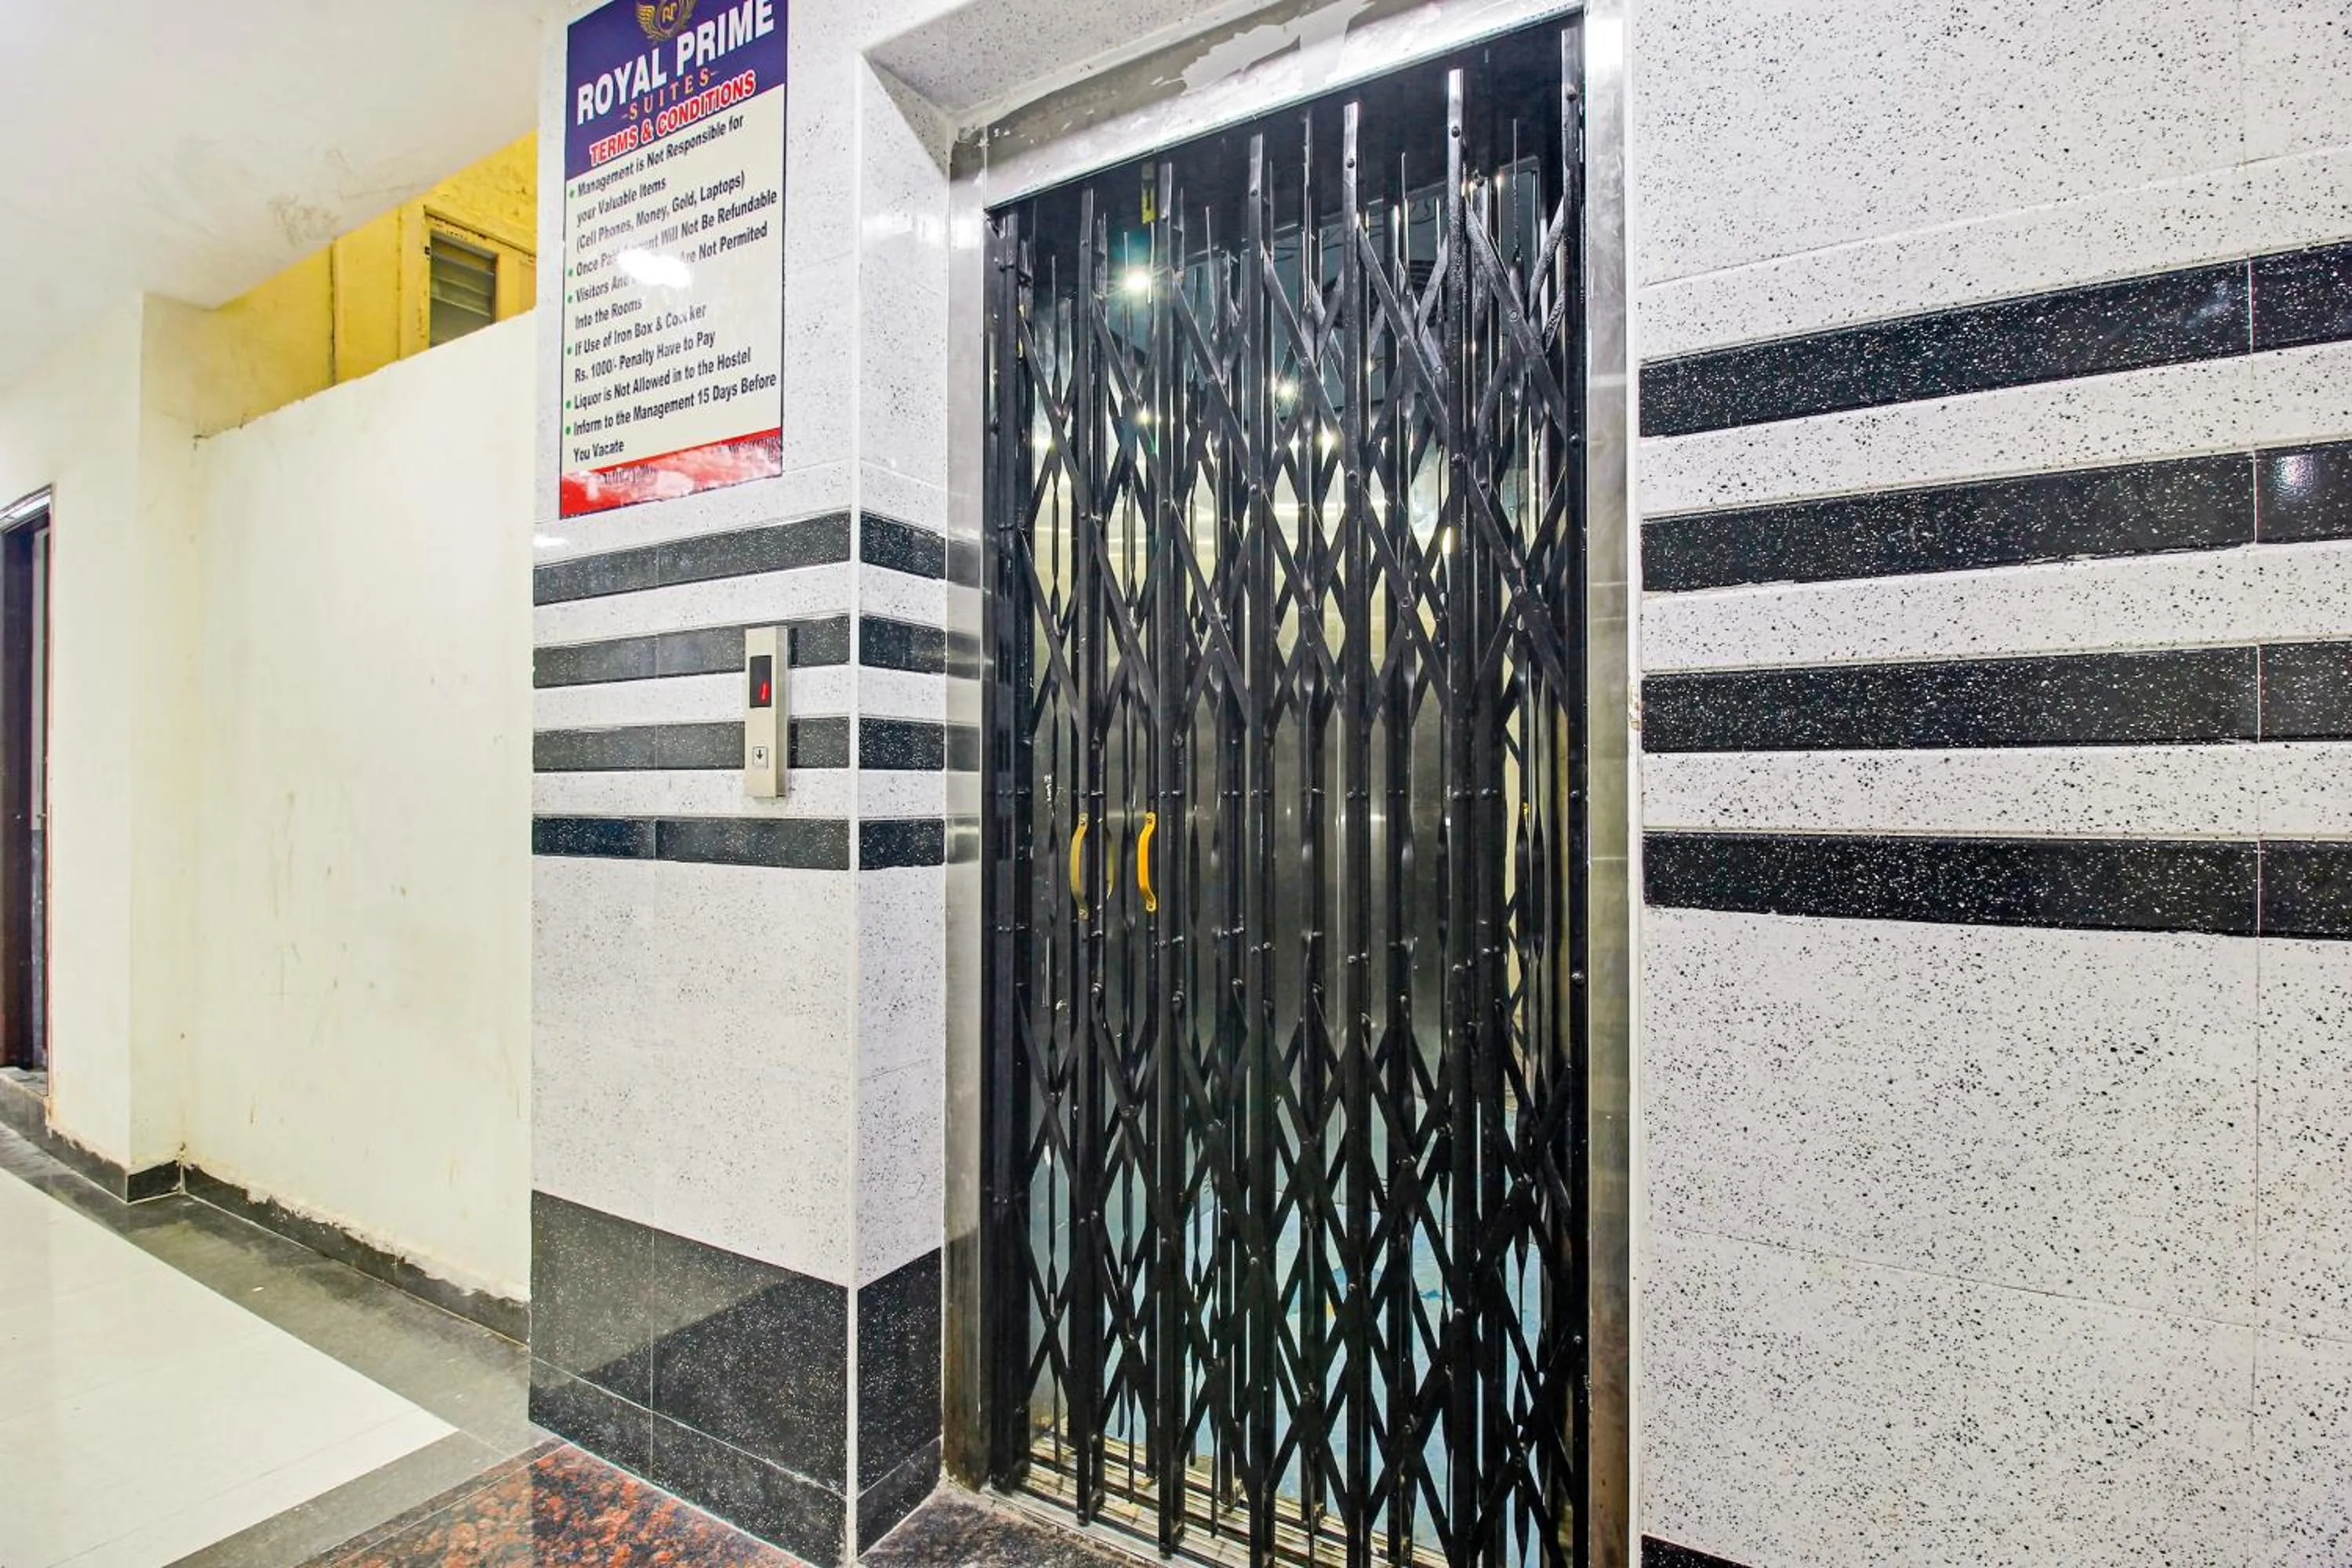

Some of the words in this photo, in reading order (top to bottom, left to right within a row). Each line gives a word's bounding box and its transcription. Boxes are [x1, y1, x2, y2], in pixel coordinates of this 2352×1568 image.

[577, 48, 667, 126] ROYAL
[677, 0, 774, 77] PRIME
[630, 67, 710, 120] SUITES
[590, 124, 638, 167] TERMS
[641, 118, 654, 144] &
[655, 69, 756, 137] CONDITIONS
[578, 162, 633, 196] Management
[636, 158, 644, 173] is
[647, 148, 664, 168] Not
[666, 122, 727, 158] Responsible
[728, 114, 743, 131] for
[576, 259, 598, 277] Once
[661, 225, 678, 245] Will
[681, 219, 699, 238] Not
[702, 213, 714, 230] Be
[717, 189, 777, 224] Refundable
[577, 207, 596, 228] your
[598, 189, 637, 214] Valuable
[639, 178, 666, 198] Items
[577, 229, 597, 253] (Cell
[598, 220, 634, 241] Phones,
[636, 205, 670, 227] Money,
[672, 191, 696, 212] Gold,
[700, 169, 745, 201] Laptops)
[575, 281, 609, 303] Visitors
[699, 241, 717, 260] Not
[575, 314, 593, 329] Into
[595, 307, 608, 323] the
[612, 299, 642, 317] Rooms
[575, 341, 582, 356] If
[584, 338, 601, 354] Use
[603, 330, 612, 347] of
[614, 328, 632, 344] Iron
[634, 322, 652, 338] Box
[574, 391, 601, 411] Liquor
[604, 387, 612, 401] is
[614, 382, 630, 399] Not
[633, 368, 670, 394] Allowed
[673, 368, 681, 383] in
[684, 365, 695, 379] to
[697, 359, 714, 376] the
[717, 346, 751, 371] Hostel
[575, 368, 588, 383] Rs.
[619, 348, 654, 370] Penalty
[656, 342, 681, 359] Have
[684, 335, 694, 351] to
[697, 331, 715, 349] Pay
[573, 419, 602, 436] Inform
[604, 415, 614, 429] to
[615, 410, 631, 426] the
[633, 393, 694, 422] Management
[698, 387, 710, 405] 15
[713, 383, 738, 401] Days
[741, 373, 777, 394] Before
[573, 448, 590, 463] You
[592, 441, 625, 458] Vacate
